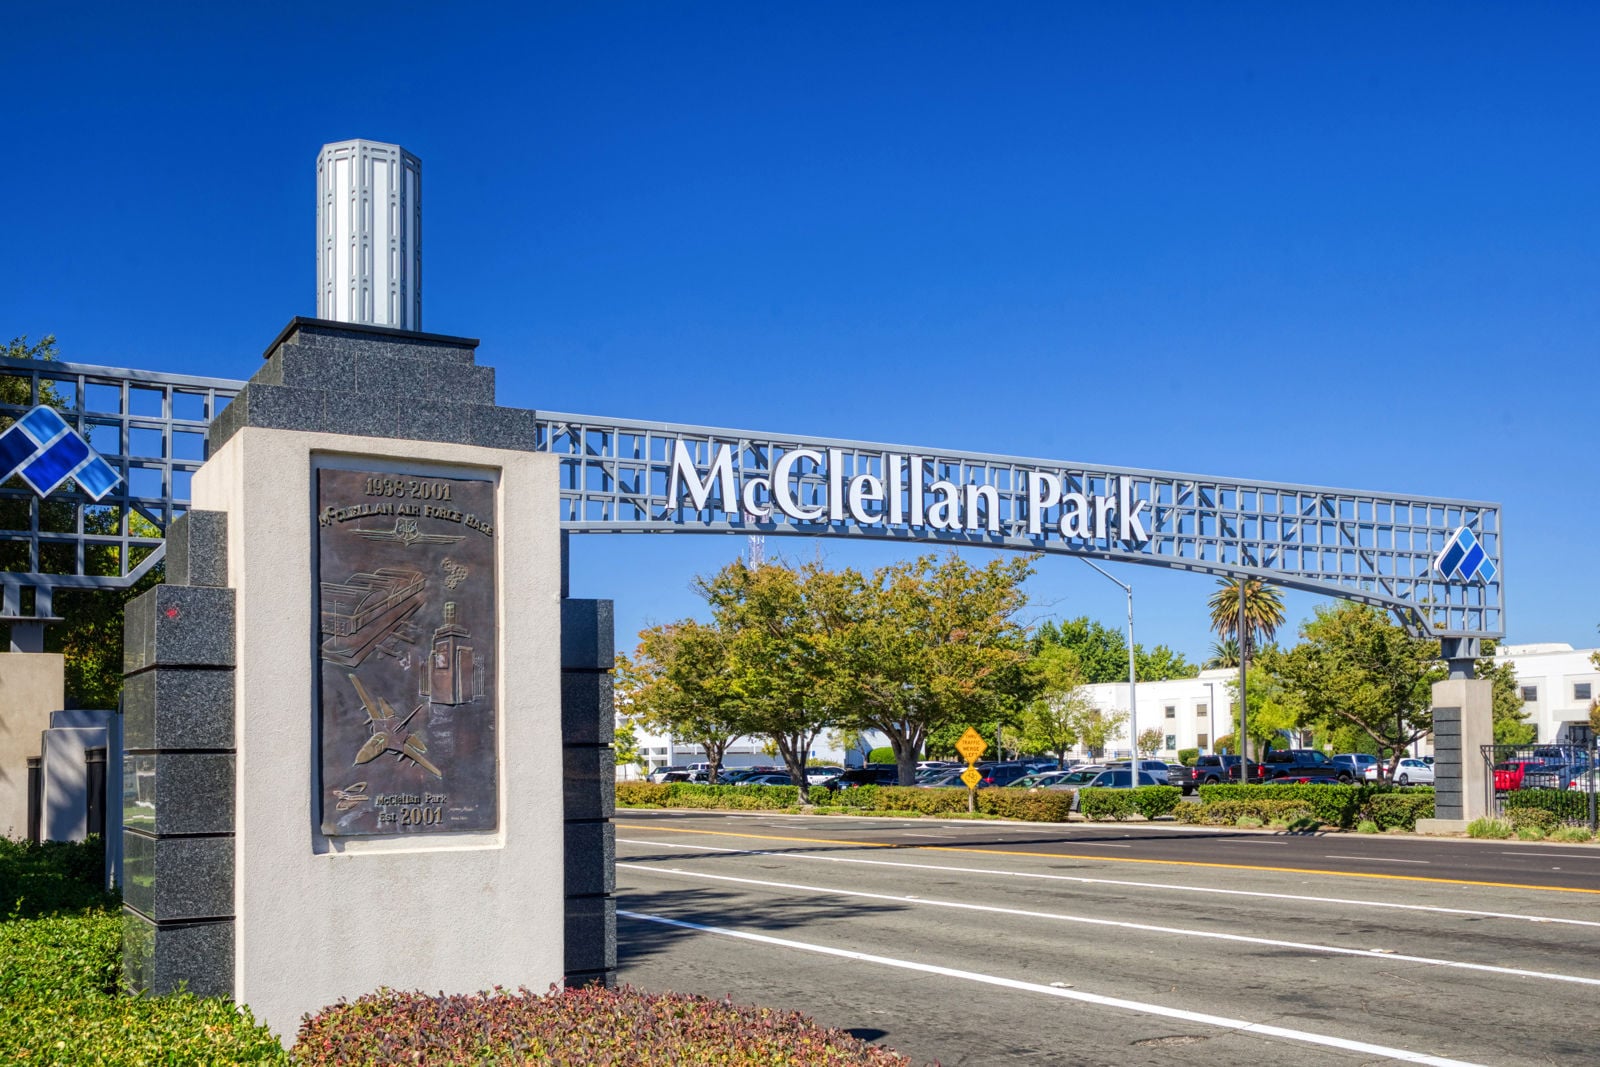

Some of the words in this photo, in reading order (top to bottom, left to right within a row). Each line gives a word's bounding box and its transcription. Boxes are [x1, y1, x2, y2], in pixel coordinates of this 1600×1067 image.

[665, 439, 1000, 532] McClellan
[1028, 471, 1148, 542] Park
[397, 502, 420, 517] AIR
[424, 504, 463, 523] FORCE
[464, 513, 494, 537] BASE
[375, 793, 421, 806] McClellan
[424, 792, 448, 804] Park
[400, 806, 443, 826] 2001
